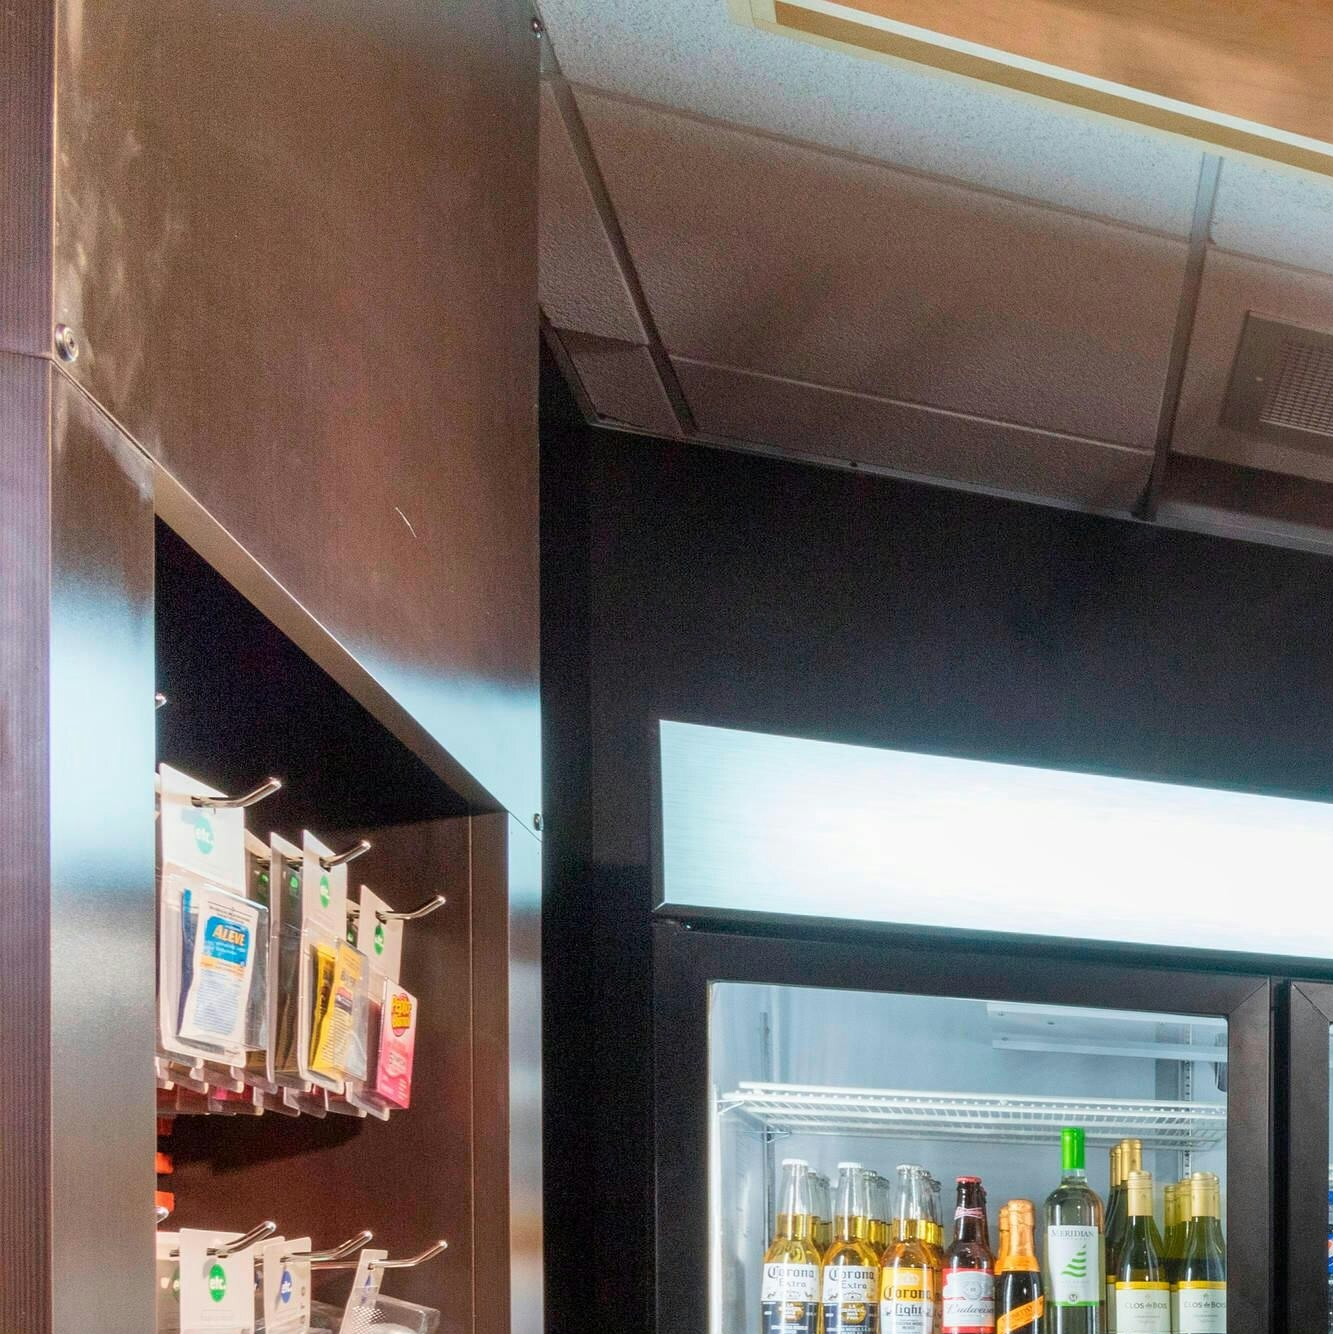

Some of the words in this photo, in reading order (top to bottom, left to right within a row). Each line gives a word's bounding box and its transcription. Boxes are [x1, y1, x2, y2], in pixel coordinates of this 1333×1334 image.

[212, 924, 246, 946] ALEVE
[1051, 1228, 1094, 1238] MERIDIAN
[829, 1267, 875, 1281] Corona
[209, 1276, 227, 1289] etc.
[884, 1285, 933, 1300] Corona
